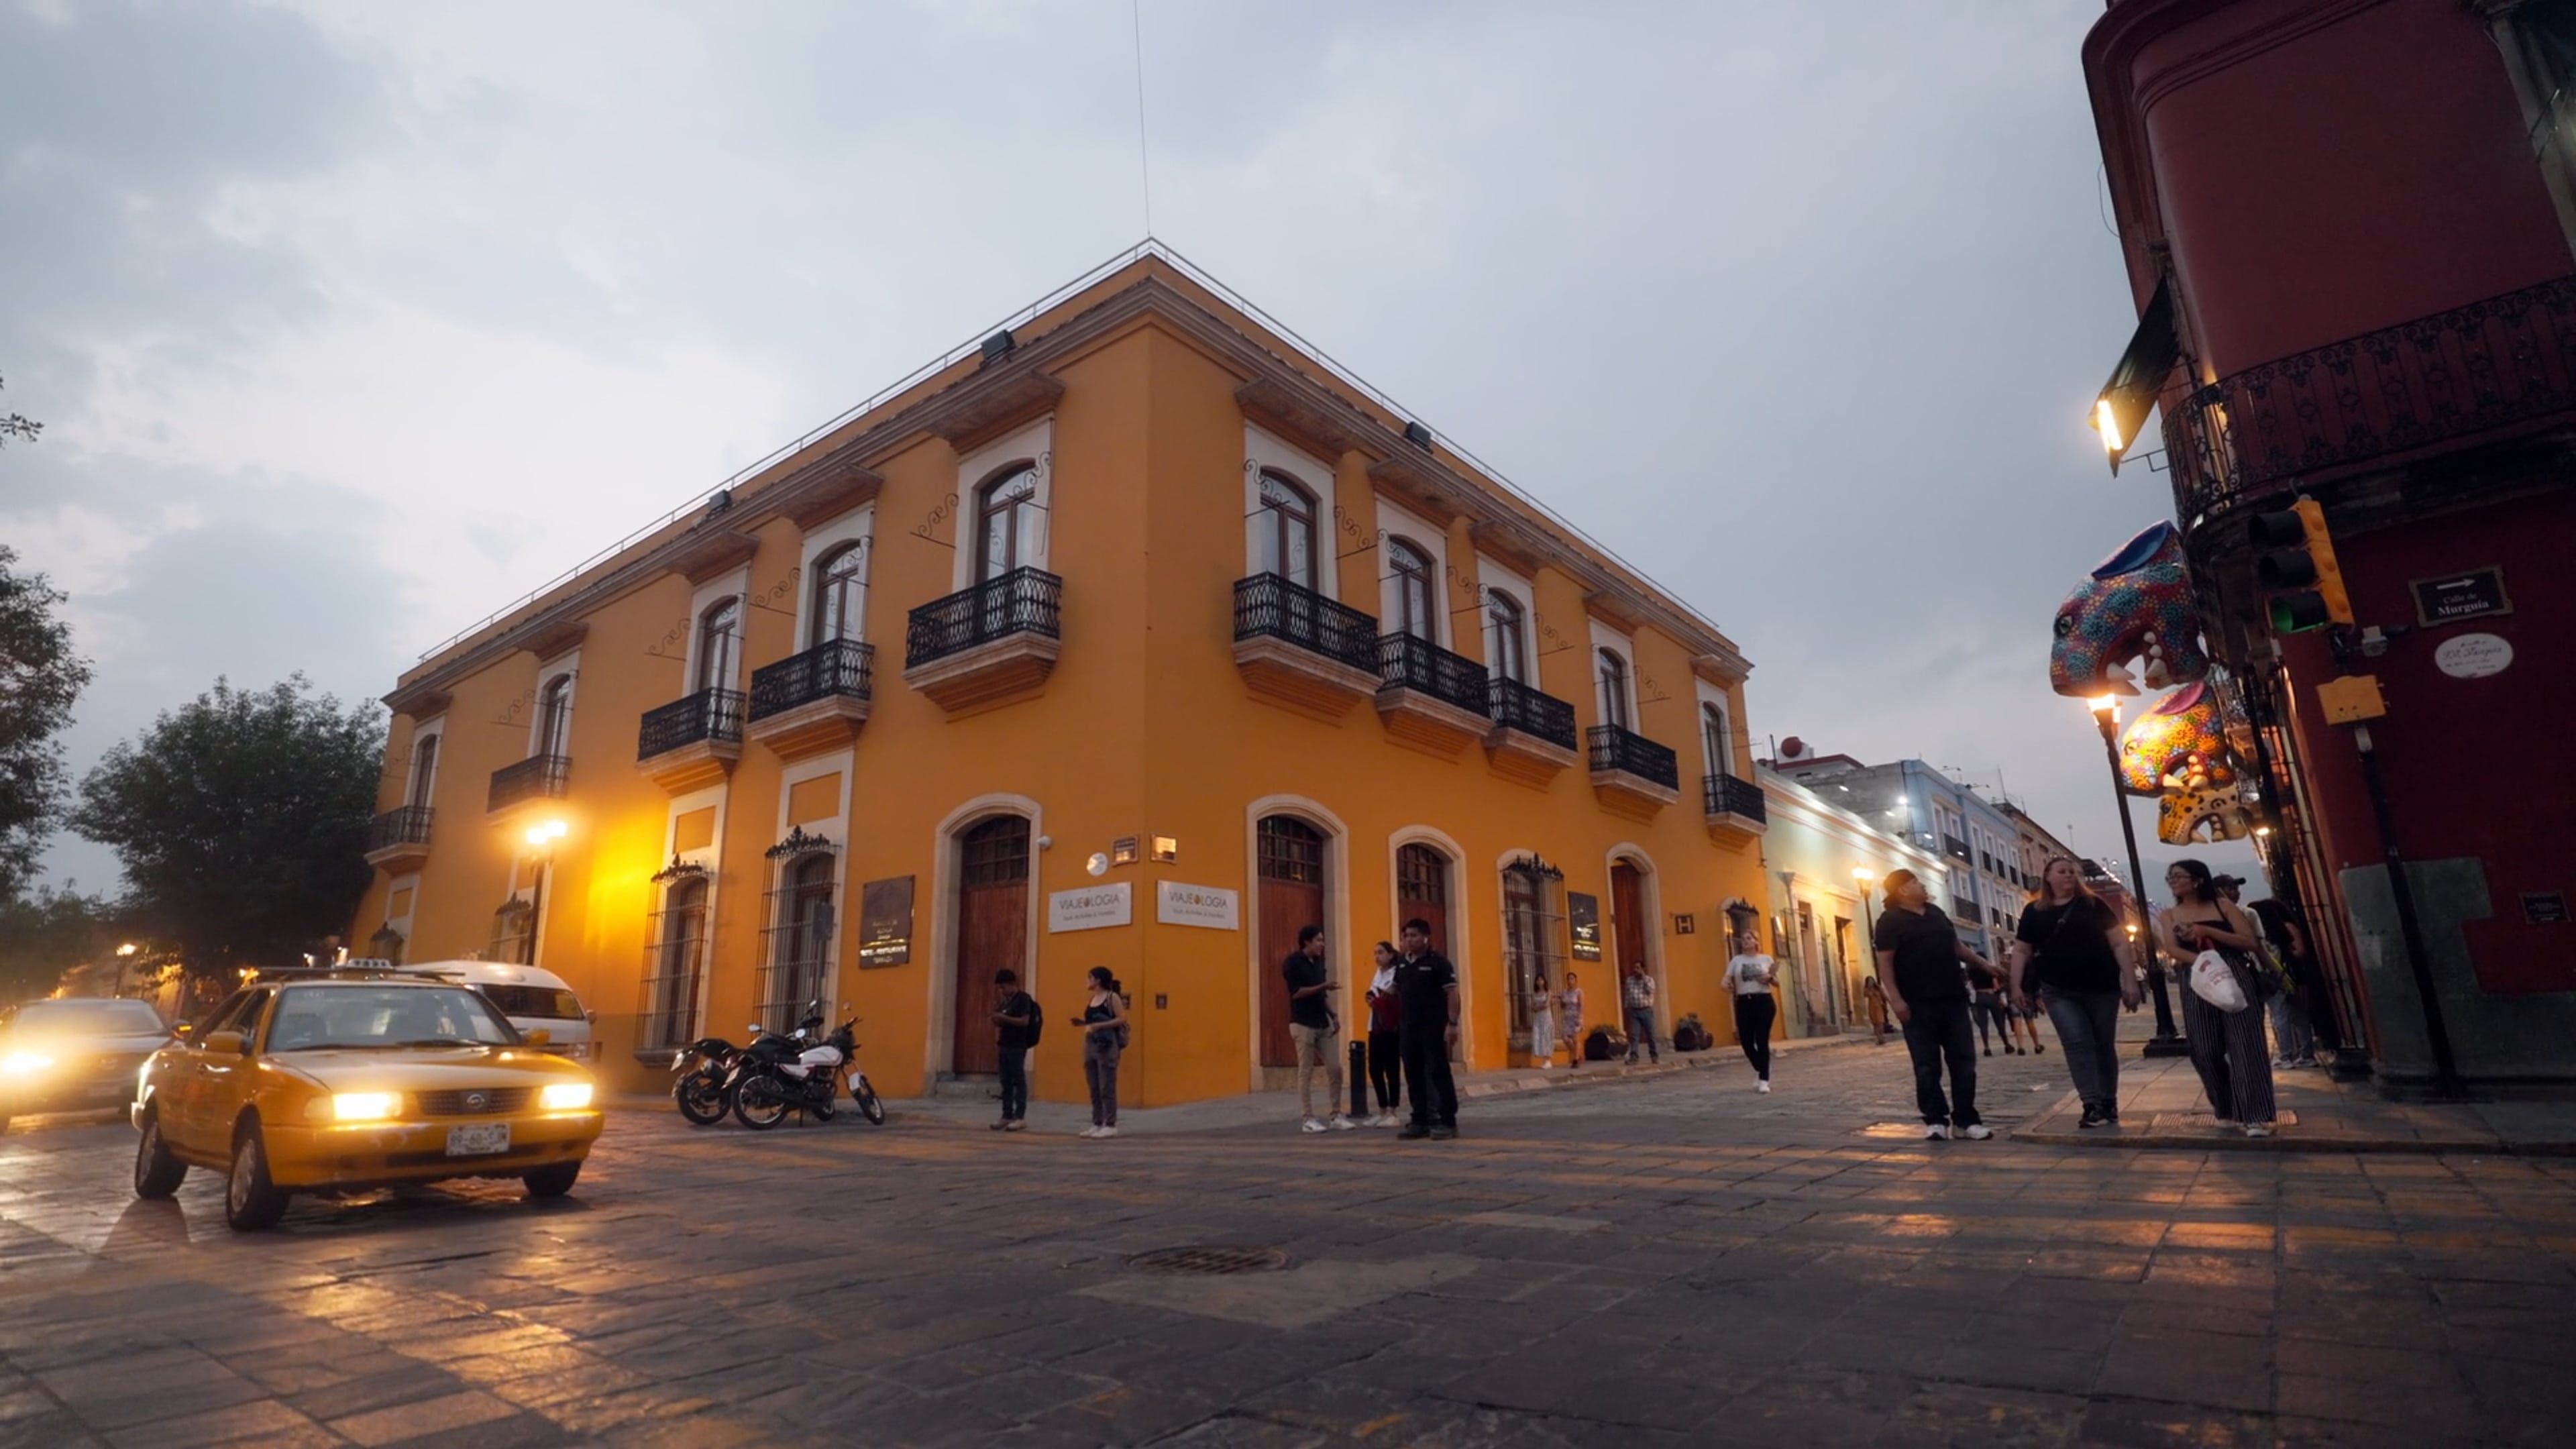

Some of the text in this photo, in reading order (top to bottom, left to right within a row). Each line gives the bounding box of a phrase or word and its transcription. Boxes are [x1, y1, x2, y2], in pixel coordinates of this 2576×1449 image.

[2443, 592, 2477, 604] Calle de
[2437, 599, 2489, 616] Murguía
[1677, 917, 1692, 933] H
